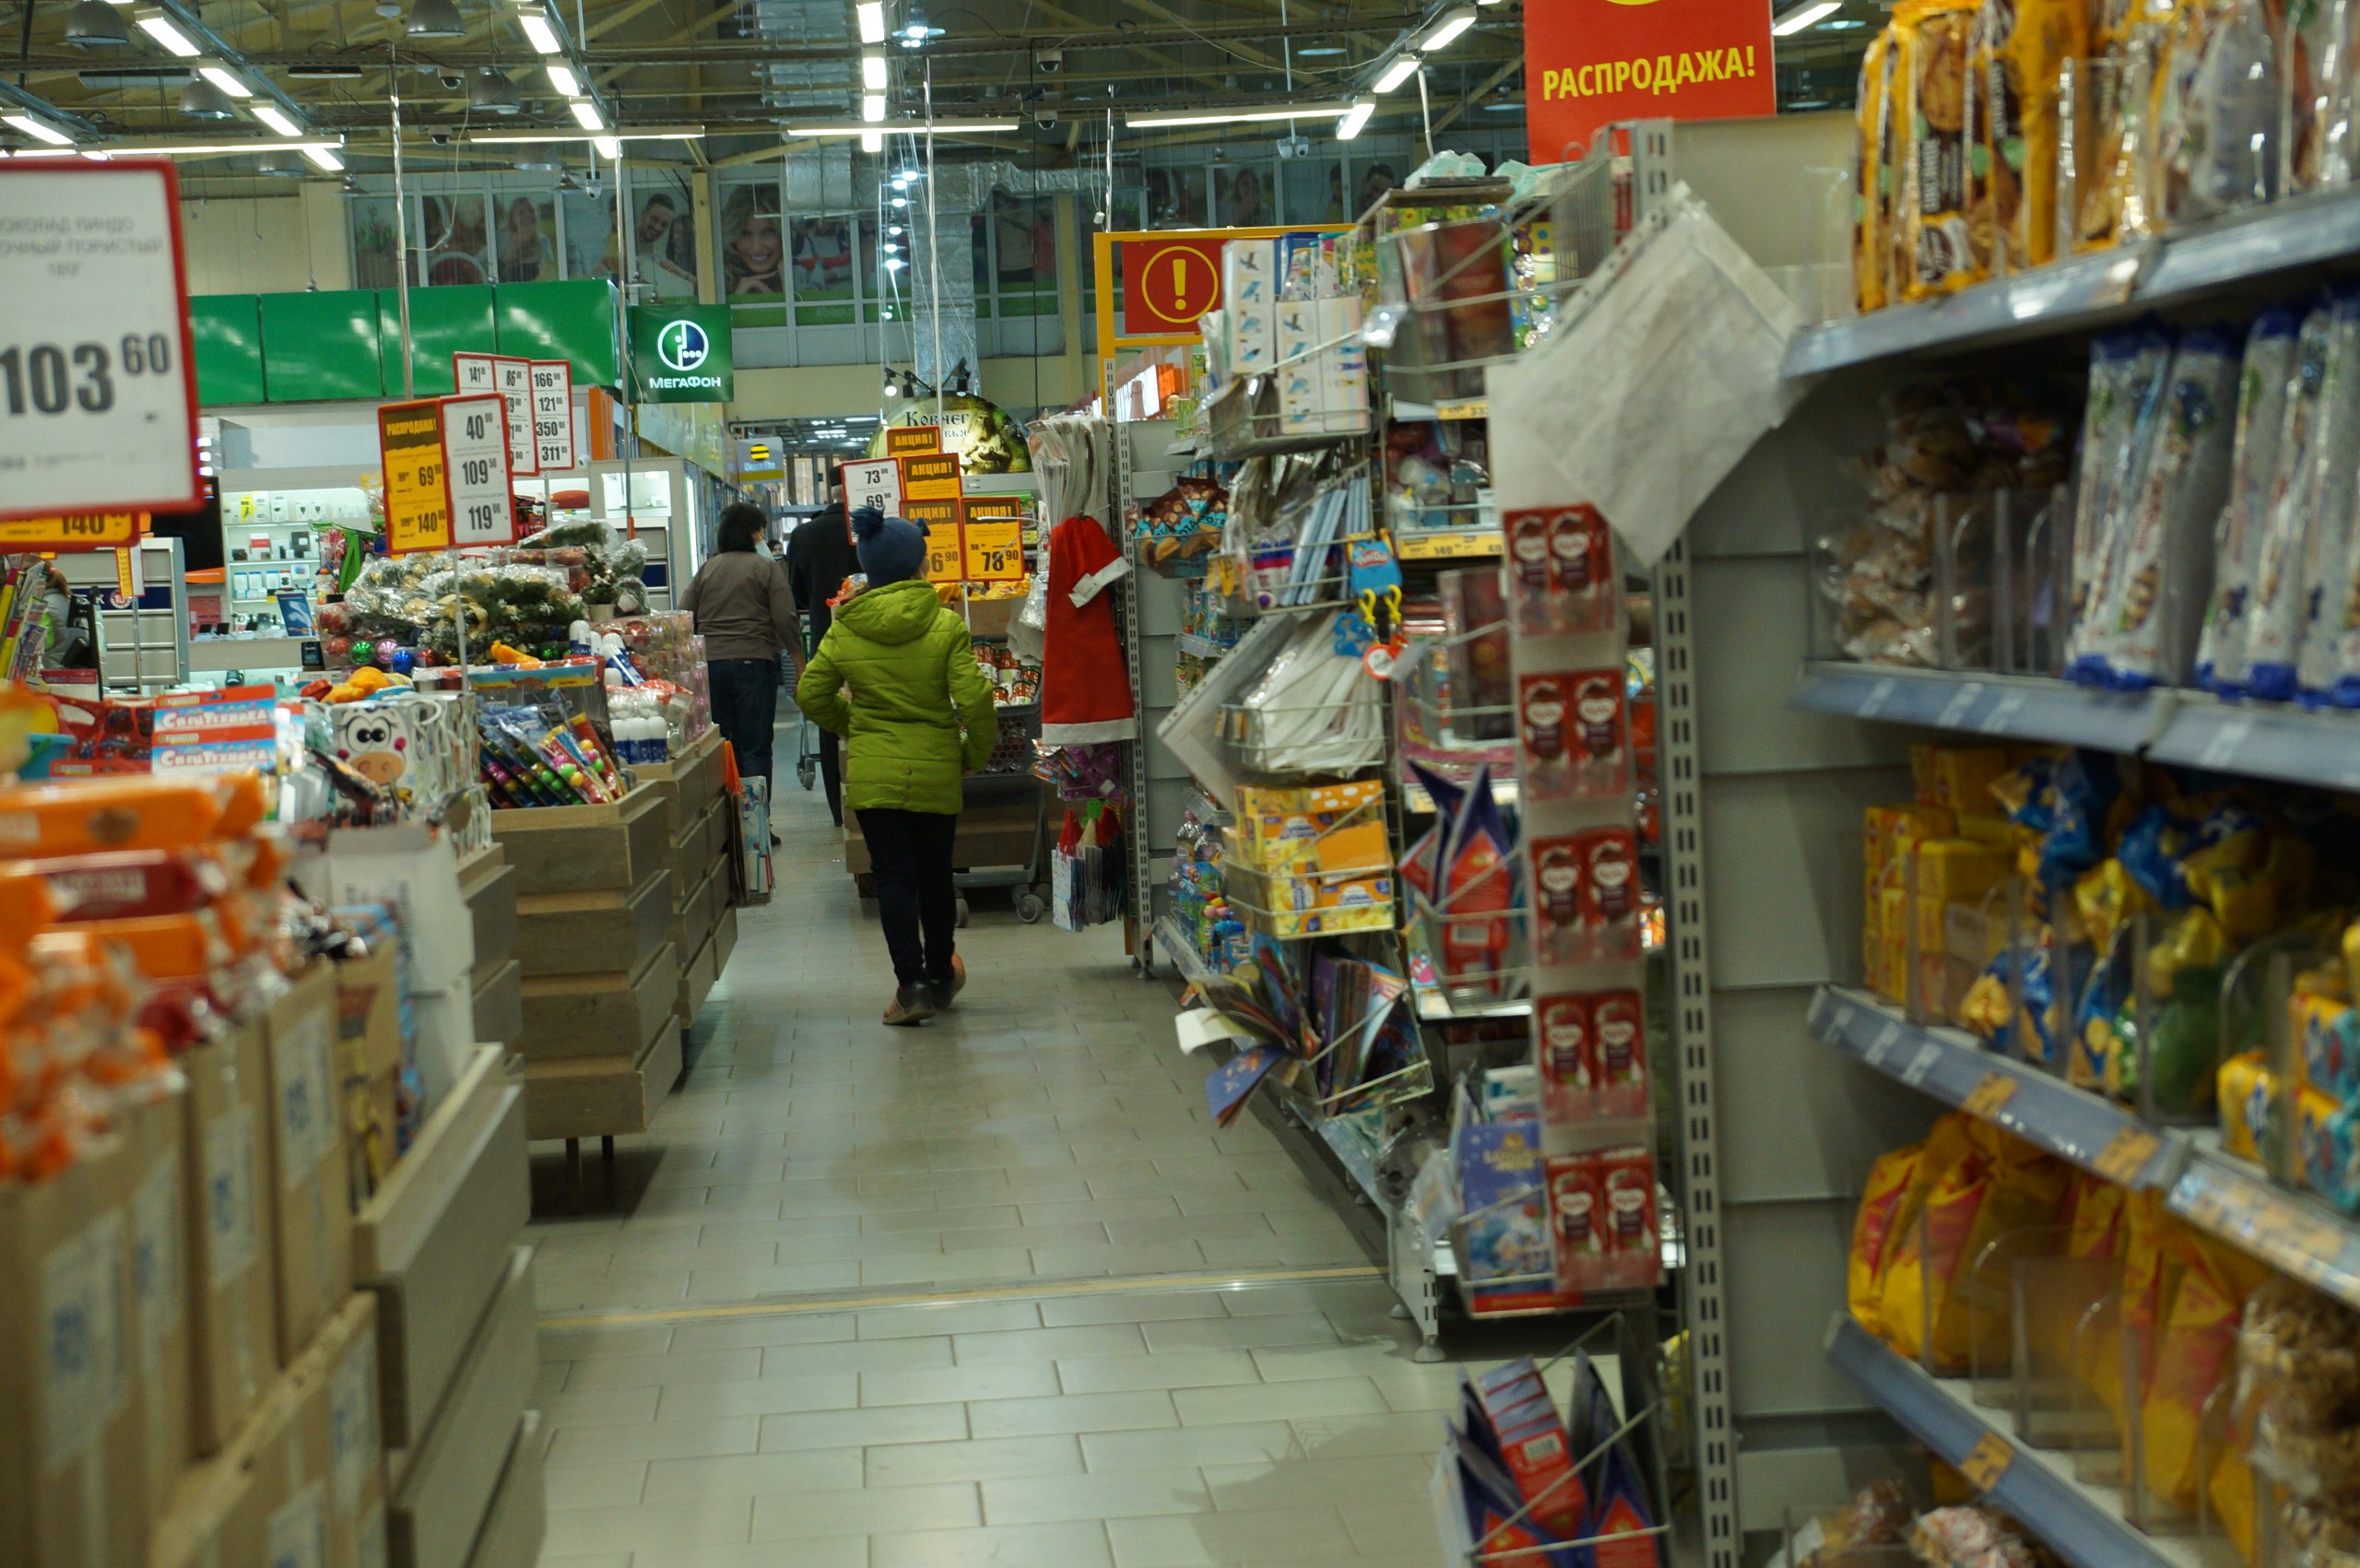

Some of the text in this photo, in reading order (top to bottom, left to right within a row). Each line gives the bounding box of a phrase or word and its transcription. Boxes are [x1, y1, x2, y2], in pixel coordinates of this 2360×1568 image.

[1542, 45, 1755, 100] РАСПРОДАЖА!
[0, 333, 171, 414] 103 60
[506, 370, 515, 387] 86
[534, 372, 553, 387] 166
[538, 396, 556, 412] 121
[466, 414, 485, 441] 40
[537, 421, 559, 437] 350
[894, 432, 933, 447] АКЦИЯ!
[542, 446, 560, 461] 311
[419, 466, 434, 487] 69
[462, 459, 489, 486] 109
[865, 469, 880, 485] 73
[911, 461, 953, 477] АКЦИЯ!
[866, 494, 884, 508] 69
[468, 504, 492, 531] 119
[908, 506, 951, 520] АКЦИЯ!
[970, 505, 1012, 518] АКЦИЯ!
[418, 512, 438, 533] 140
[945, 550, 959, 562] 90
[981, 549, 1019, 572] 78 90
